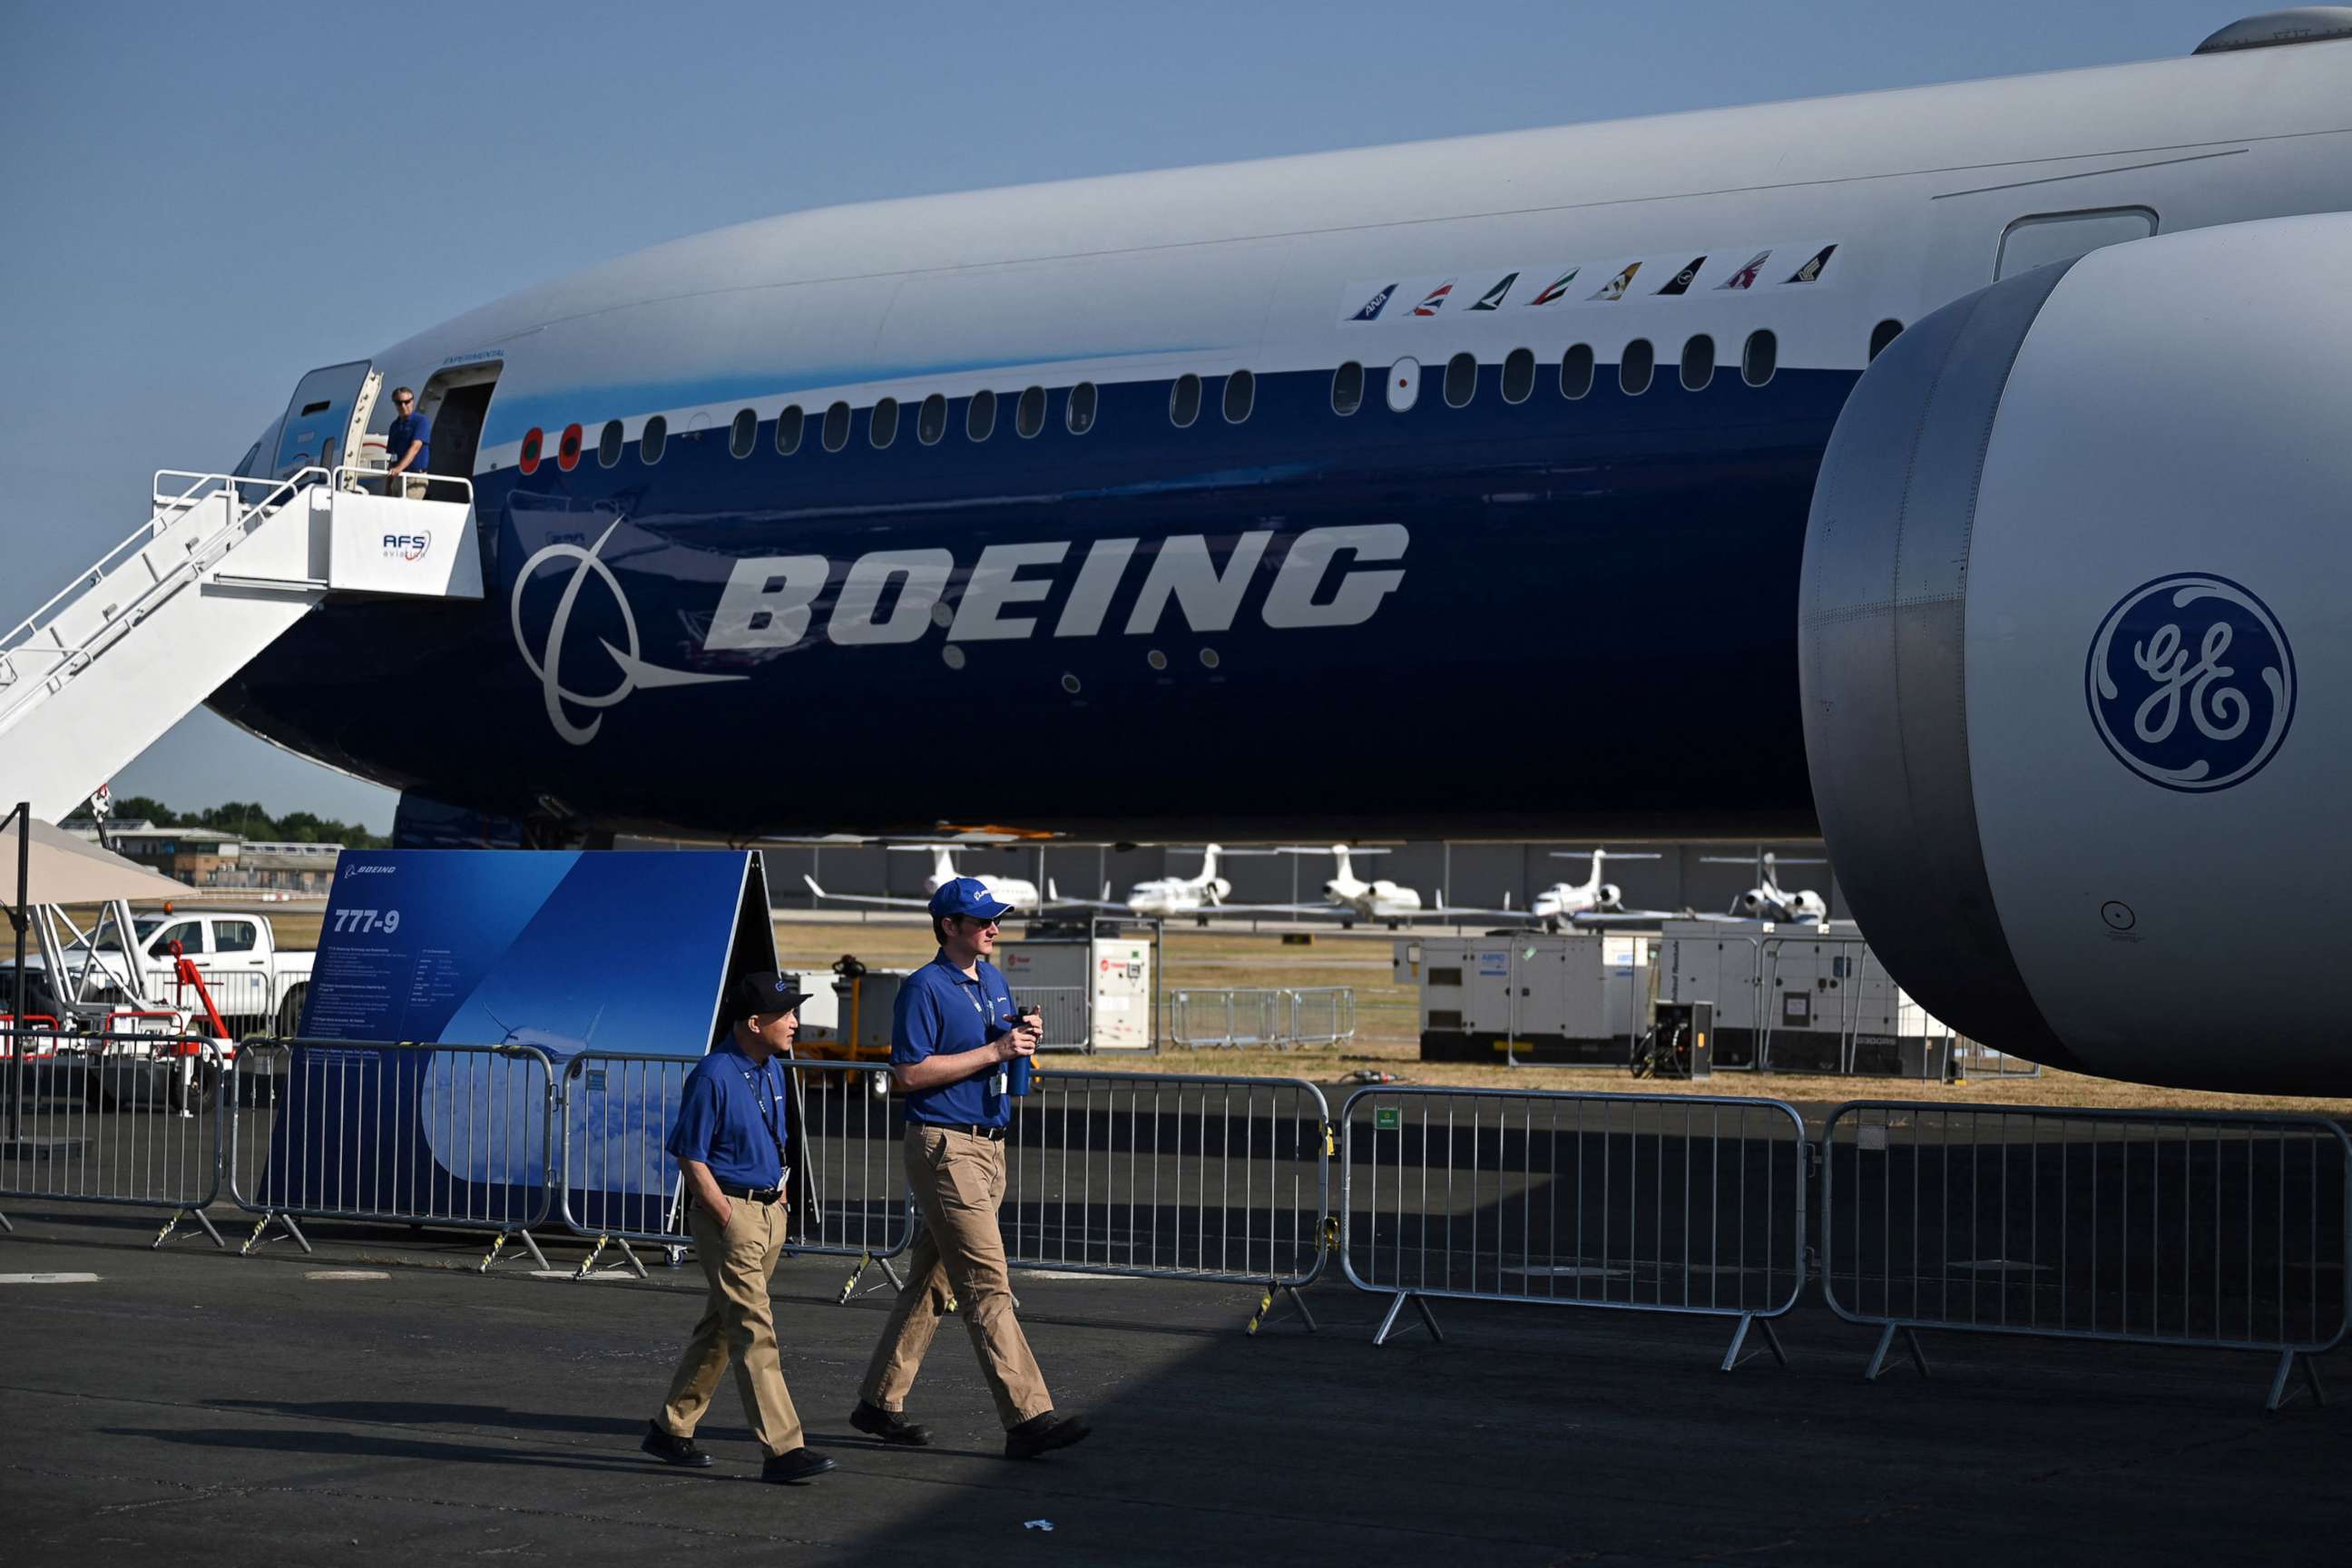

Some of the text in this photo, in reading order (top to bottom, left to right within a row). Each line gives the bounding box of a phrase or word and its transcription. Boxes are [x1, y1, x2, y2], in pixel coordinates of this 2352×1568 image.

[1365, 293, 1387, 317] ANA
[384, 534, 425, 549] AFS
[704, 524, 1409, 650] BOEING
[2134, 622, 2250, 743] GE
[357, 866, 397, 874] BOEING
[334, 909, 400, 934] 777-9
